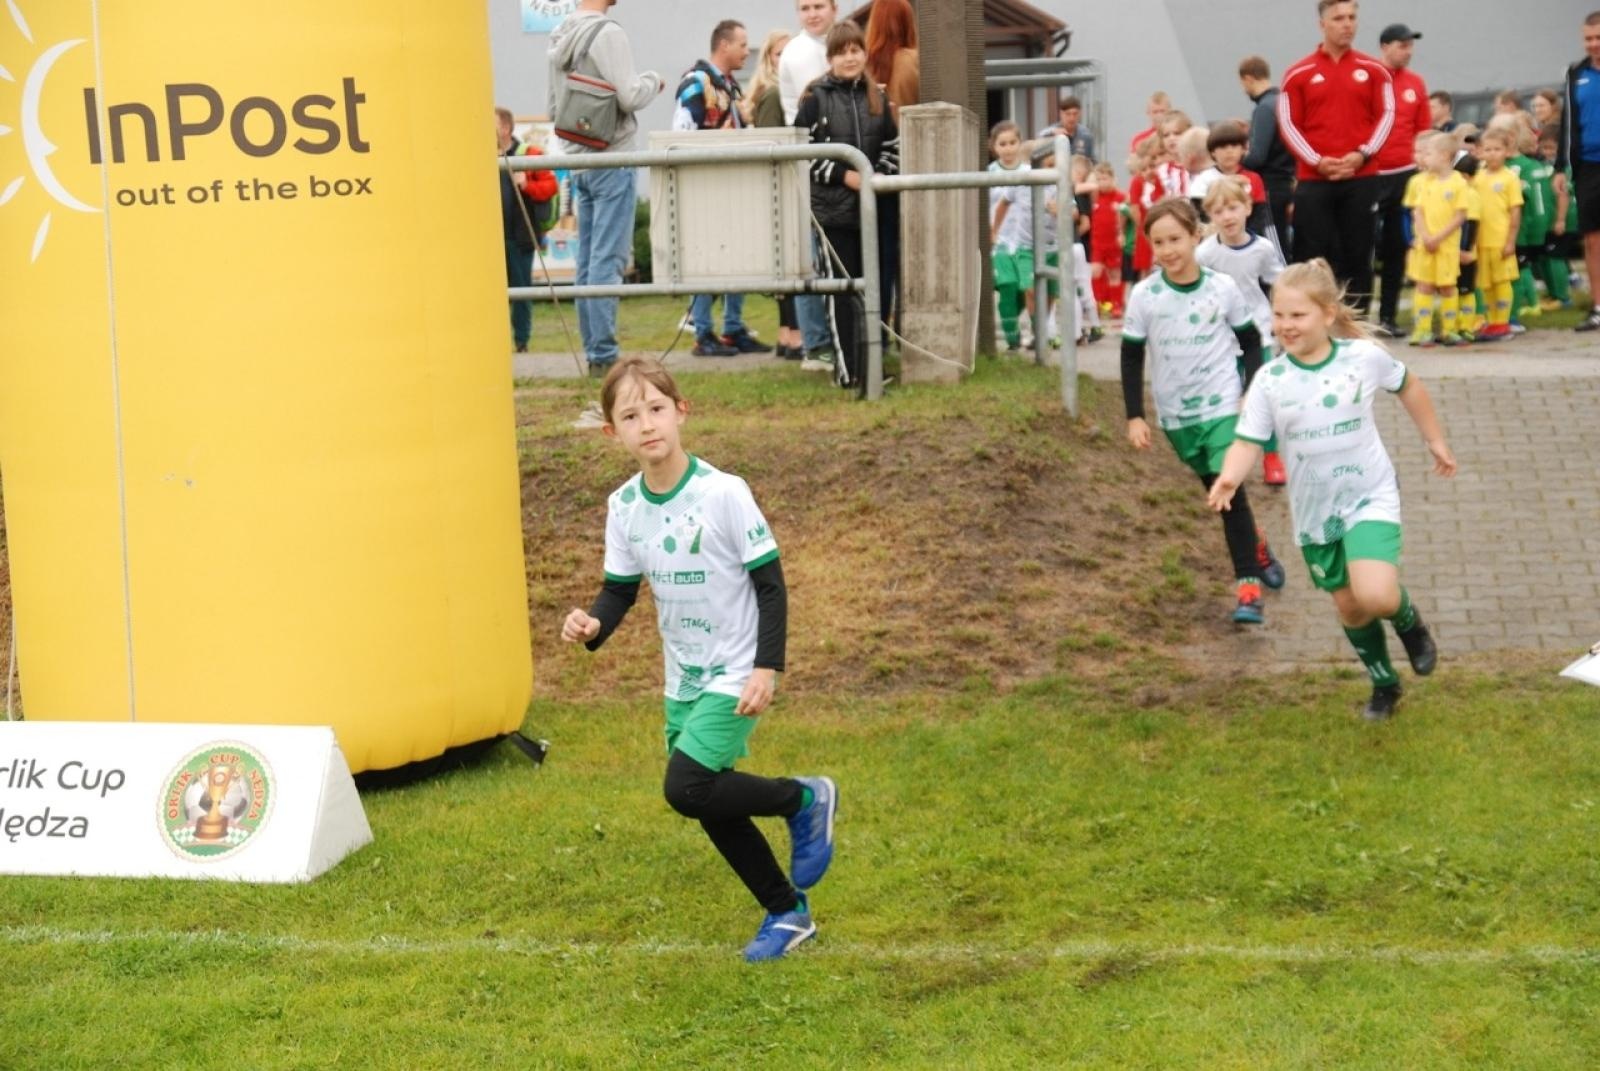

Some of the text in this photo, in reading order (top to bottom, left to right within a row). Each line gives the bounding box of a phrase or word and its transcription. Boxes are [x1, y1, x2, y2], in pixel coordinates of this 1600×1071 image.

[527, 0, 575, 18] NĘDZ
[83, 77, 370, 164] InPost
[116, 175, 373, 206] out of the box
[674, 570, 705, 585] auto
[209, 754, 240, 764] CUP
[57, 760, 126, 798] Cup
[168, 770, 192, 820] ORLIK
